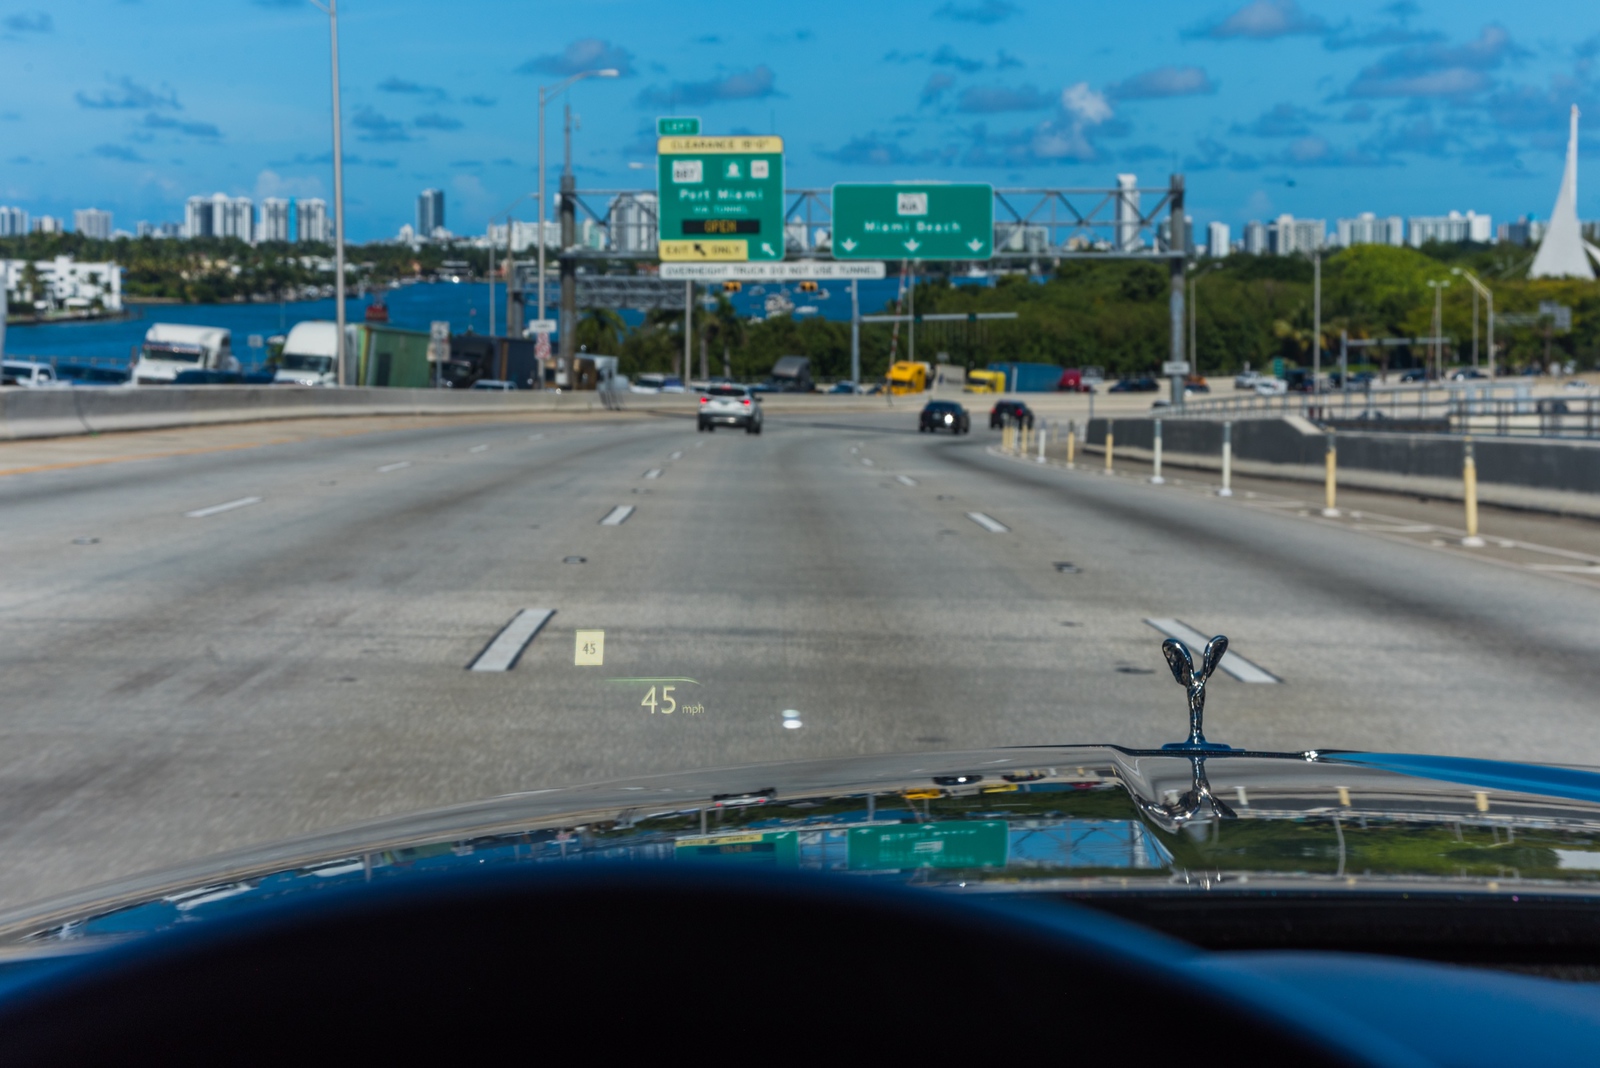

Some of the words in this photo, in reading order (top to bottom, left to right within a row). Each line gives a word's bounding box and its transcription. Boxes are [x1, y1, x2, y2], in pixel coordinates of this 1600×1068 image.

[671, 139, 734, 151] CLEARANCE
[680, 188, 710, 200] Port
[717, 188, 762, 200] Miami
[713, 205, 748, 214] TUNNEL
[704, 220, 737, 233] OPEN
[864, 220, 909, 232] Miami
[916, 220, 960, 232] Beach
[666, 245, 688, 255] EXIT
[712, 245, 742, 255] ONLY
[665, 265, 727, 276] OVERHEIGHT
[733, 265, 765, 276] TRUCK
[770, 265, 786, 276] DO
[789, 265, 809, 275] NOT
[813, 265, 832, 275] USE
[839, 265, 877, 275] TUNNEL
[582, 643, 596, 655] 45
[641, 685, 677, 715] 45
[682, 702, 705, 715] mph
